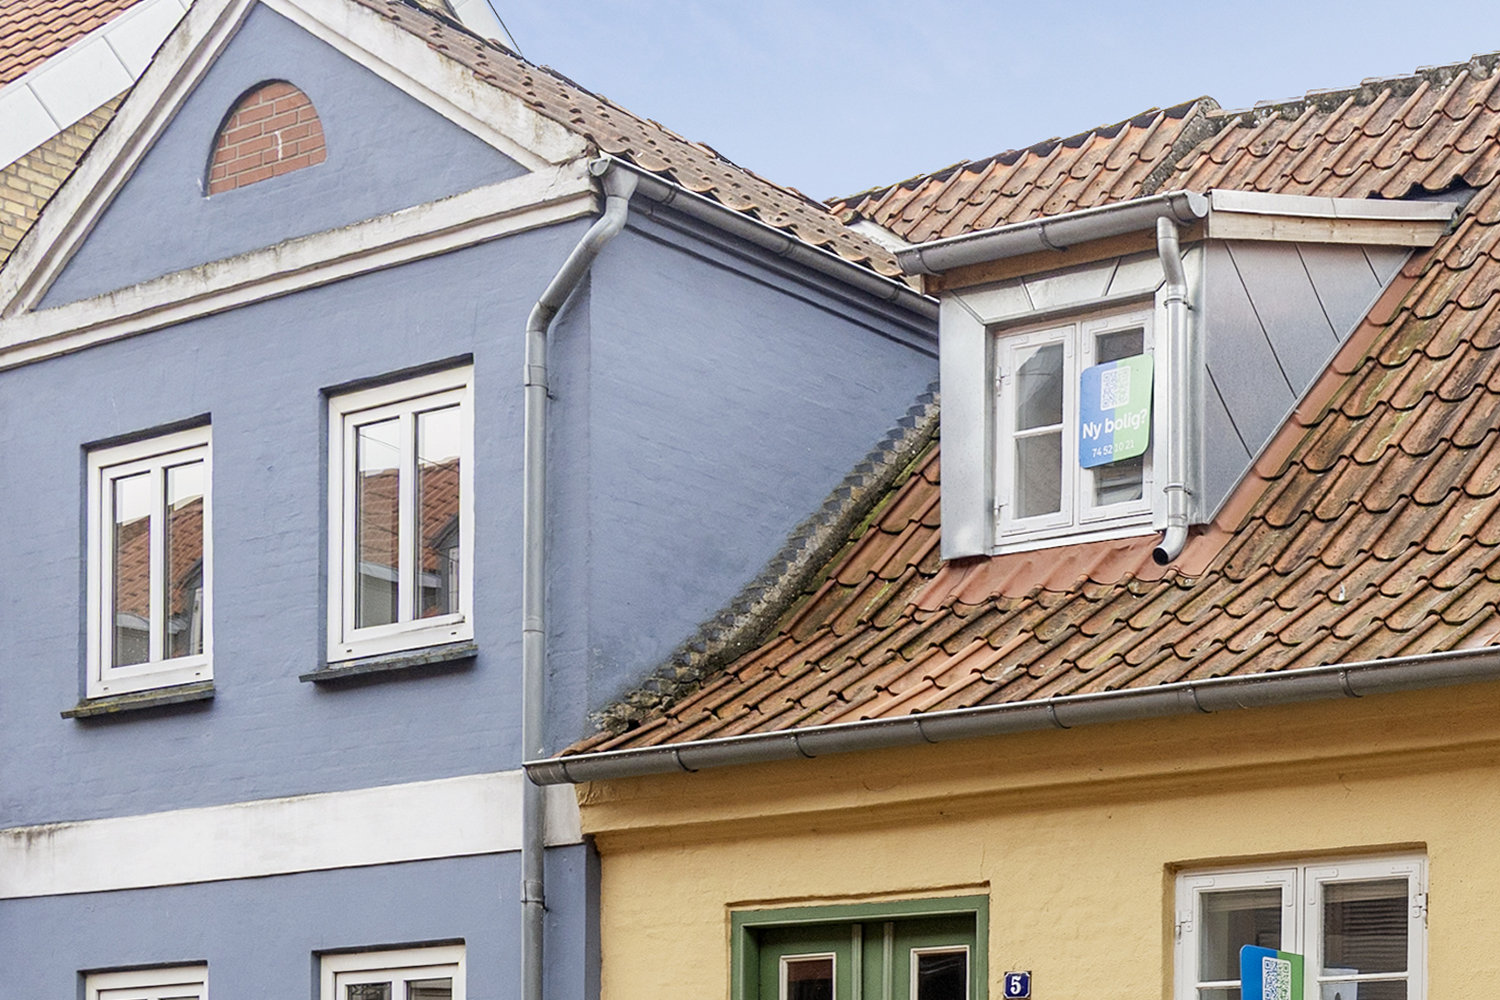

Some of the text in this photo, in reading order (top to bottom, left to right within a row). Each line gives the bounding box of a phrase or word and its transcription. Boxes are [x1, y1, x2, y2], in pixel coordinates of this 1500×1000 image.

[1082, 408, 1148, 440] Ny bolig?
[1092, 447, 1102, 458] 74
[1103, 444, 1113, 456] 52
[1125, 439, 1135, 450] 21
[1010, 975, 1022, 995] 5
